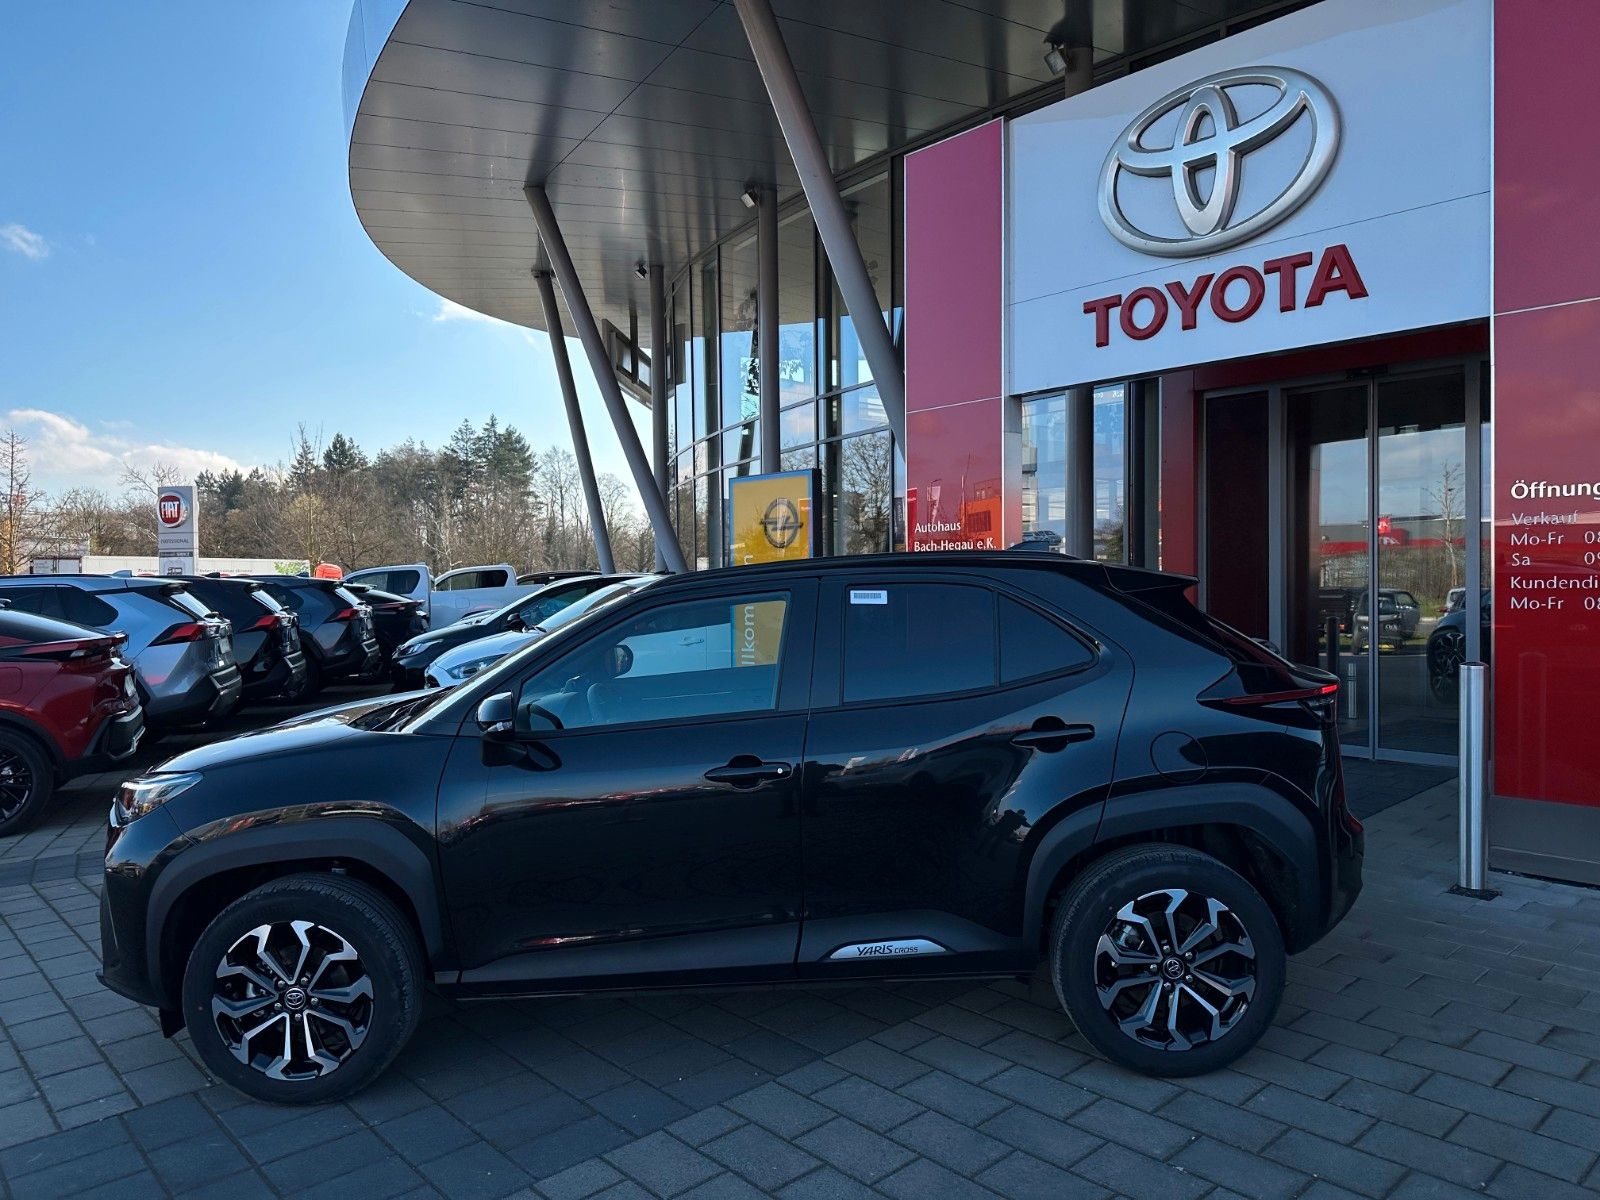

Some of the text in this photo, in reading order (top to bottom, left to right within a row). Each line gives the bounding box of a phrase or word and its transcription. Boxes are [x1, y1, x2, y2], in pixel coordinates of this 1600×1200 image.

[1083, 244, 1369, 348] TOYOTA
[160, 501, 179, 519] FIAT
[1512, 510, 1578, 526] Verkauf
[915, 520, 961, 533] Autohaus
[914, 537, 996, 552] Bach-Hegau e.K.
[1510, 530, 1600, 546] Mo-Fr 0
[1511, 551, 1600, 567] Sa 0
[1510, 575, 1599, 589] Kundendi
[1510, 596, 1600, 610] Mo-Fr 0
[856, 944, 919, 956] YARIS CROSS
